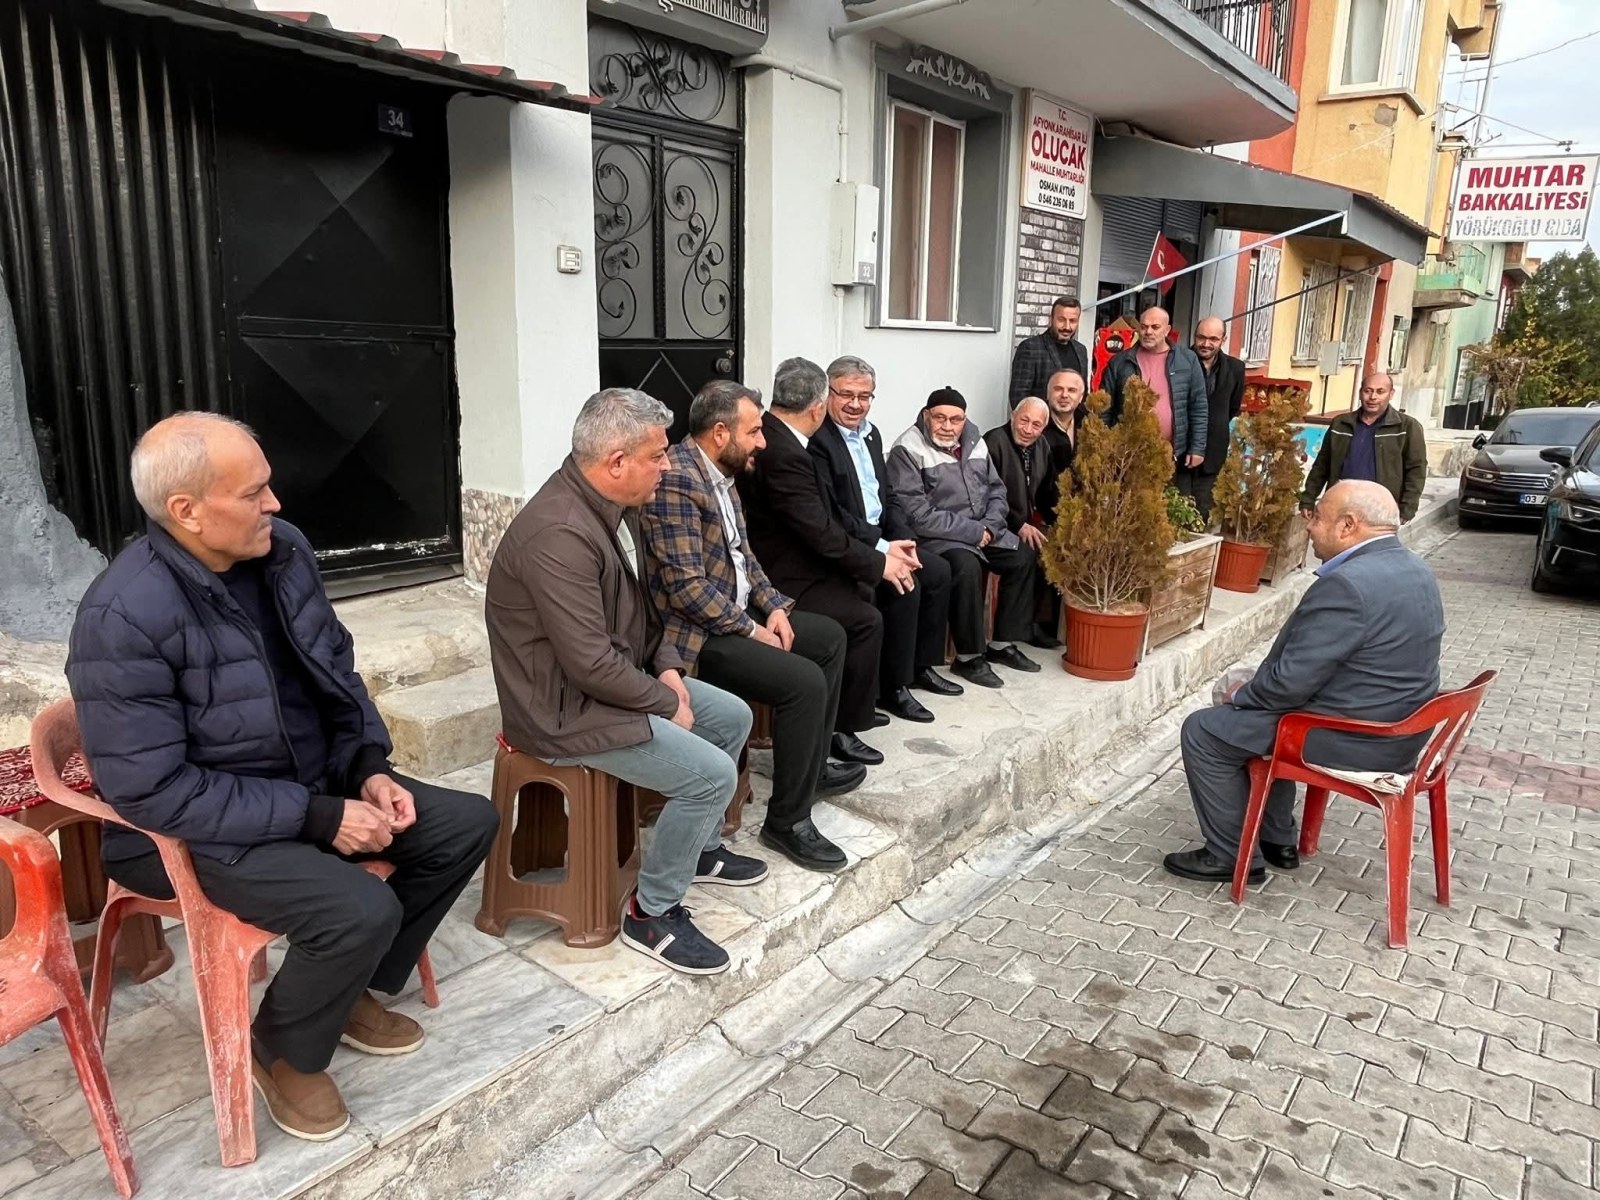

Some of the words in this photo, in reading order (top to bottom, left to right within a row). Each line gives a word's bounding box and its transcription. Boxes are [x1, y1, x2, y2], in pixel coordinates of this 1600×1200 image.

[388, 110, 403, 128] 34
[1032, 130, 1086, 170] OLUCAK
[1031, 161, 1055, 176] MAHALLE
[1467, 164, 1586, 189] MUHTAR
[1039, 179, 1058, 193] OSMAN
[1038, 193, 1042, 203] 0
